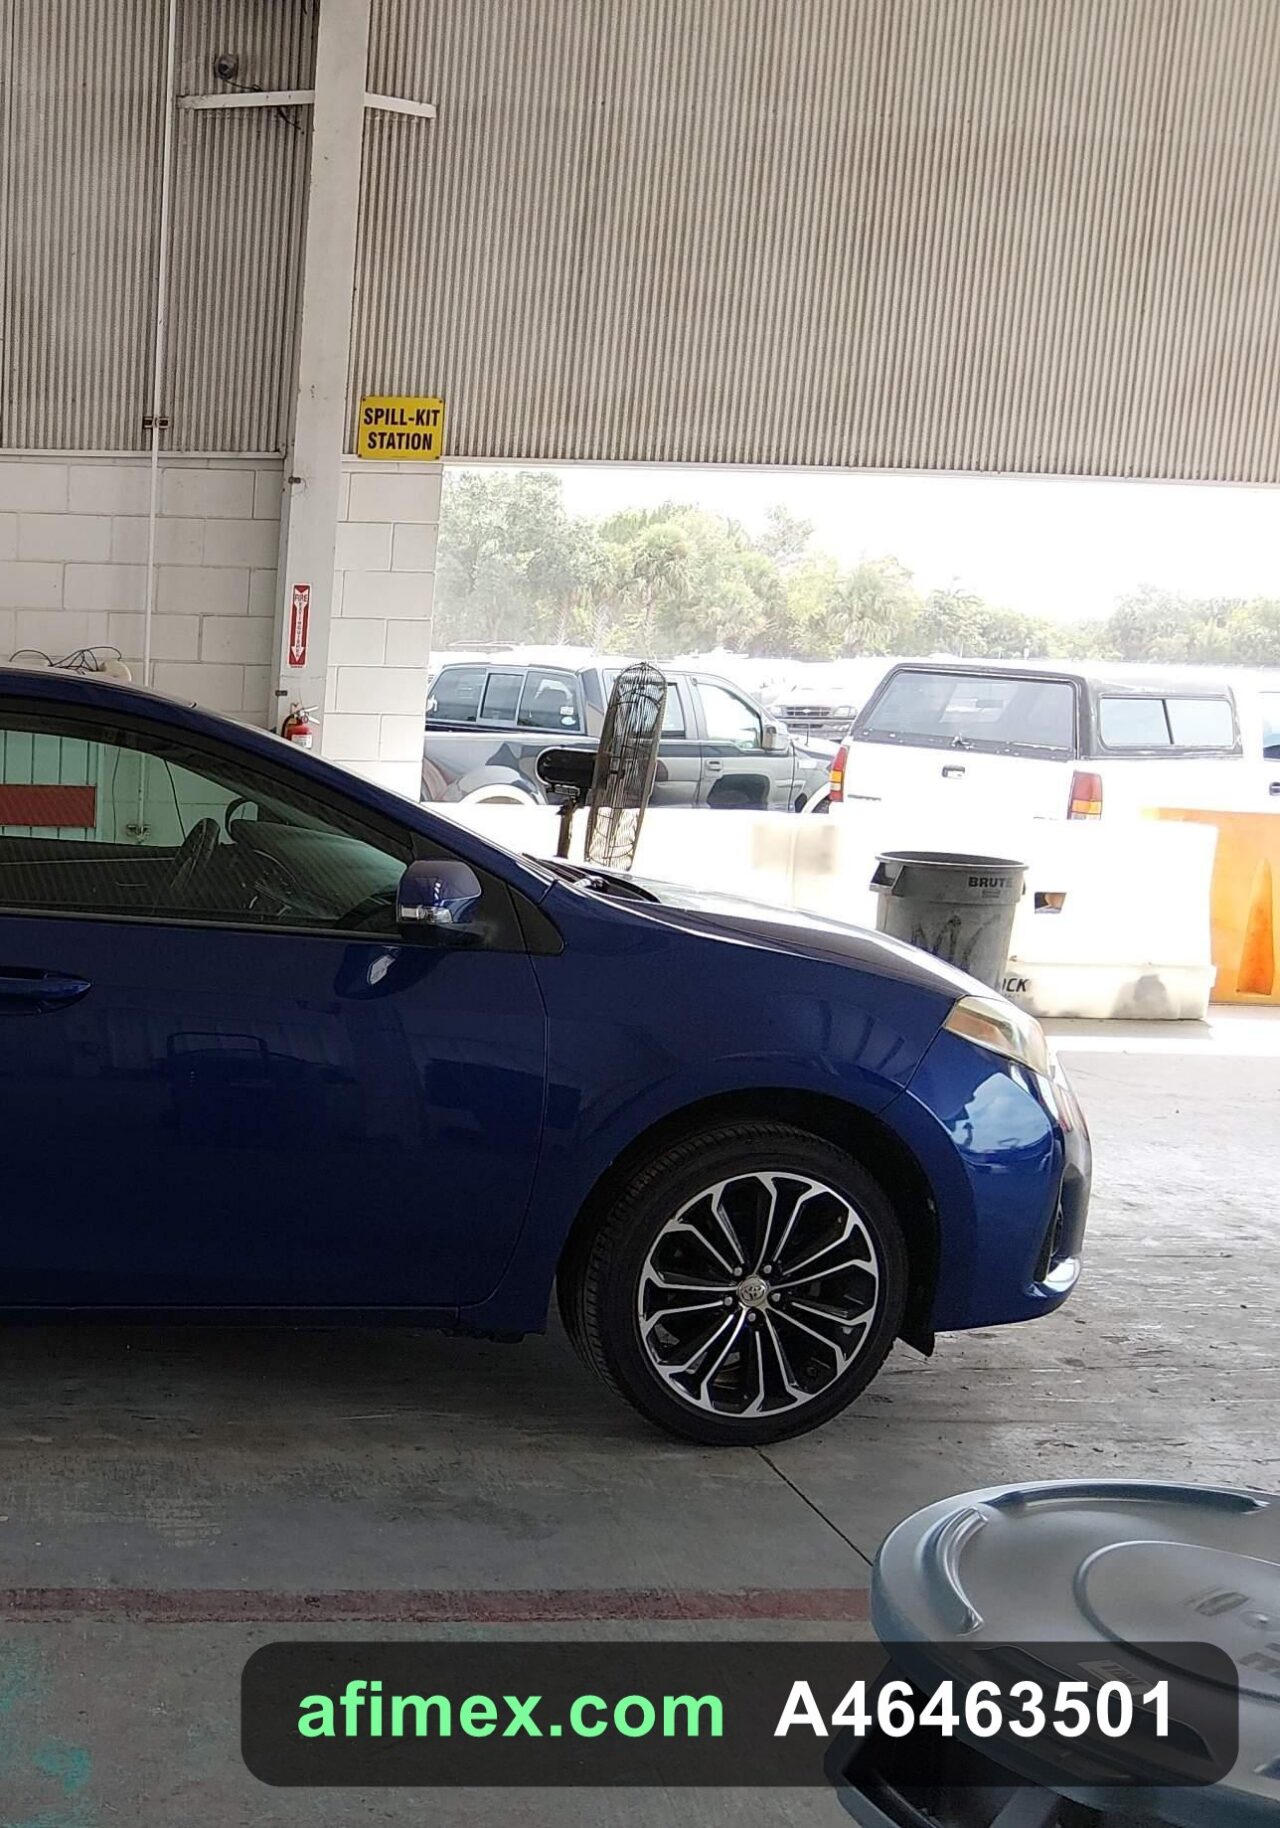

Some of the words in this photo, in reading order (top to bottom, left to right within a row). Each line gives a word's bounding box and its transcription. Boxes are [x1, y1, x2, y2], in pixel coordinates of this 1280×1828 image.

[364, 407, 440, 426] SPILL-KIT
[368, 432, 432, 450] STATION
[968, 876, 1013, 888] BRUTE
